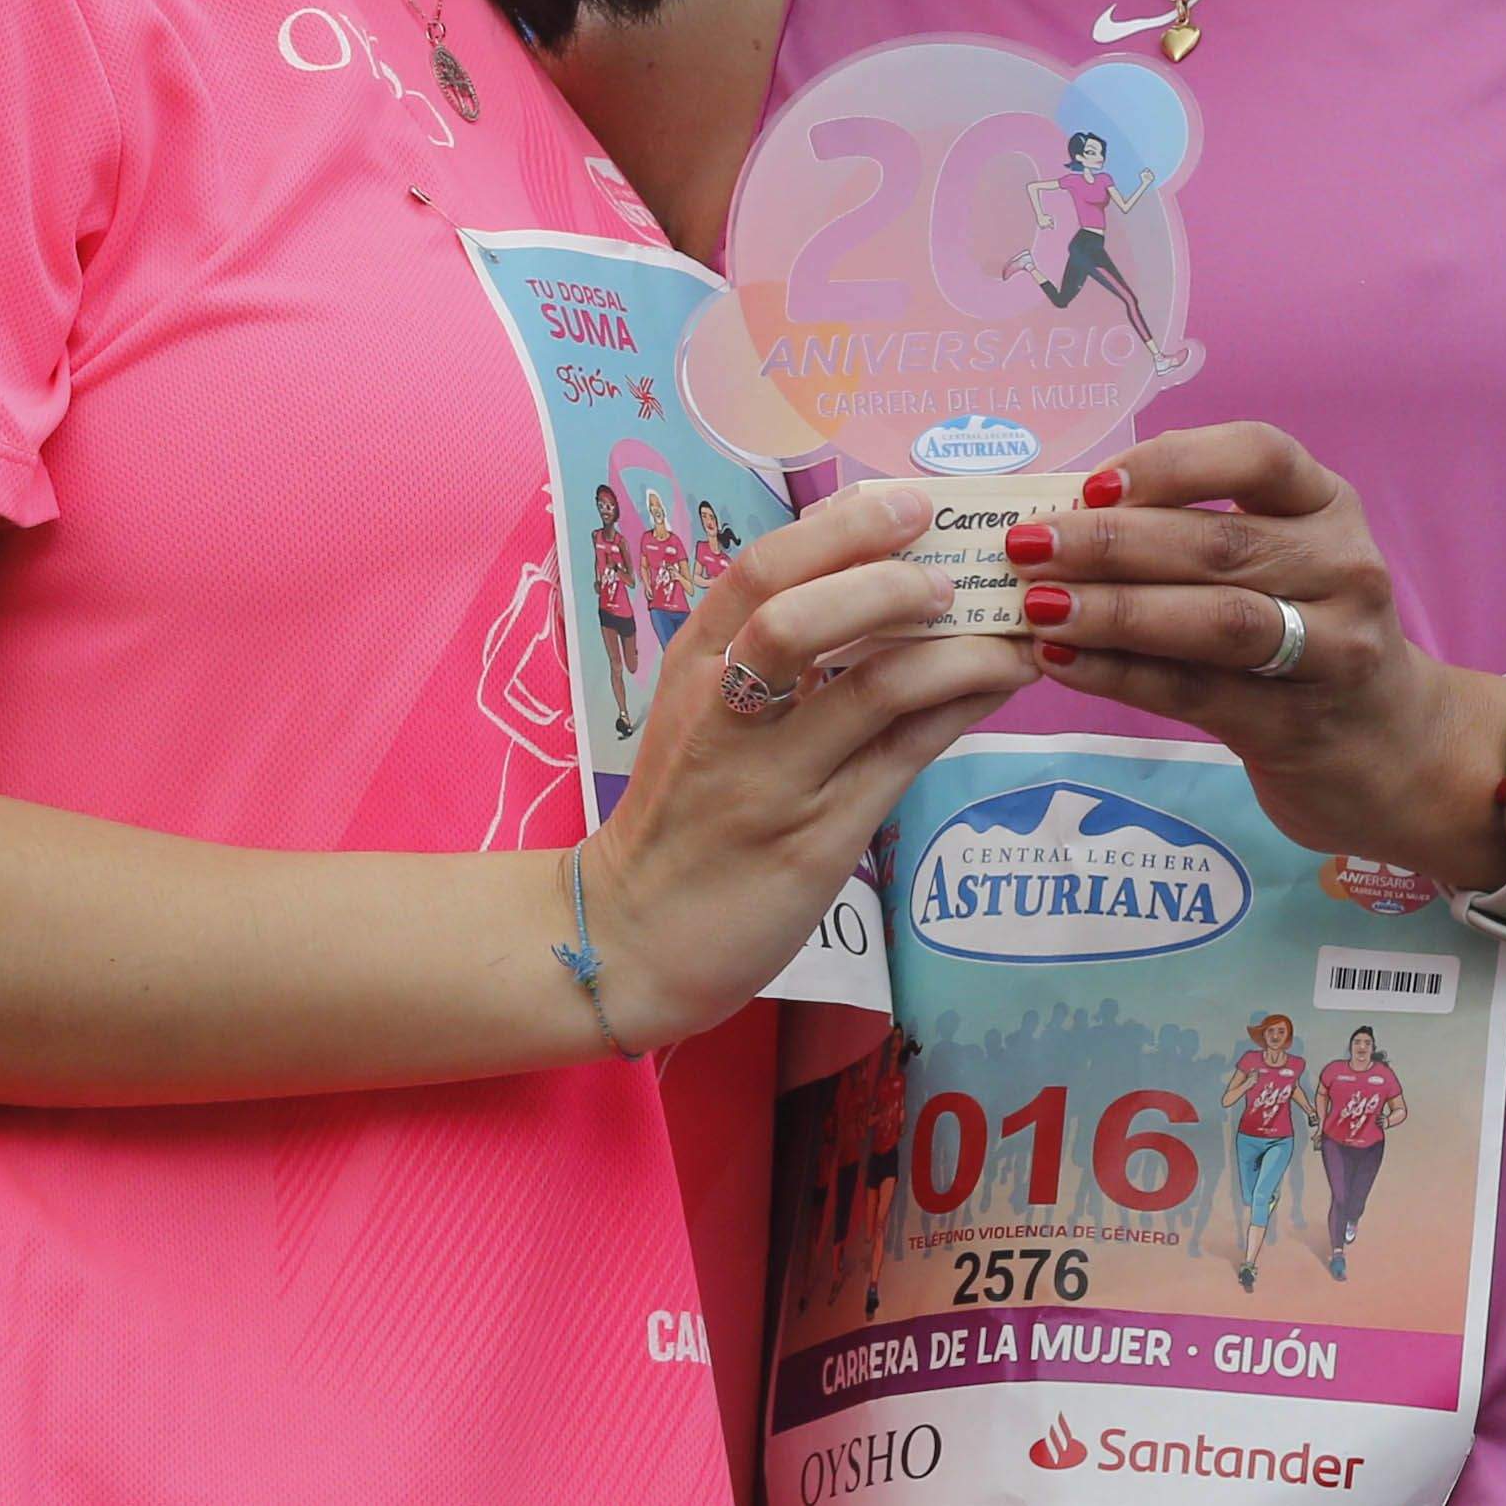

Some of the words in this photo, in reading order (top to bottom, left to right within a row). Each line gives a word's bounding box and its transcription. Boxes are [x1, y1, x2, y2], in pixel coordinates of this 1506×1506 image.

[787, 111, 1079, 324] 20
[525, 277, 553, 302] TU
[557, 279, 628, 315] DORSAL
[540, 303, 639, 354] SUMA
[760, 324, 1136, 379] ANIVERSARIO
[816, 389, 936, 419] CARRERA
[947, 387, 979, 413] DE
[990, 385, 1022, 411] LA
[1031, 382, 1119, 410] MUJER
[926, 436, 1030, 458] ASTURIANA
[966, 608, 986, 623] 16
[993, 606, 1011, 622] de
[961, 847, 1073, 864] CENTRAL
[1087, 848, 1212, 872] LECHERA
[919, 854, 1220, 926] ASTURIANA
[910, 1085, 1202, 1216] 016
[909, 1226, 975, 1250] TELÉFONO
[978, 1225, 1068, 1240] VIOLENCIA
[1073, 1225, 1096, 1239] DE
[1101, 1225, 1180, 1245] GÉNERO
[952, 1249, 1090, 1306] 2576
[821, 1336, 919, 1397] CARRERA
[928, 1332, 967, 1371] DE
[977, 1328, 1018, 1366] LA
[1031, 1327, 1171, 1369] MUJER
[1213, 1328, 1338, 1381] GIJÓN
[801, 1424, 942, 1506] OYSHO
[1097, 1428, 1365, 1491] Santander
